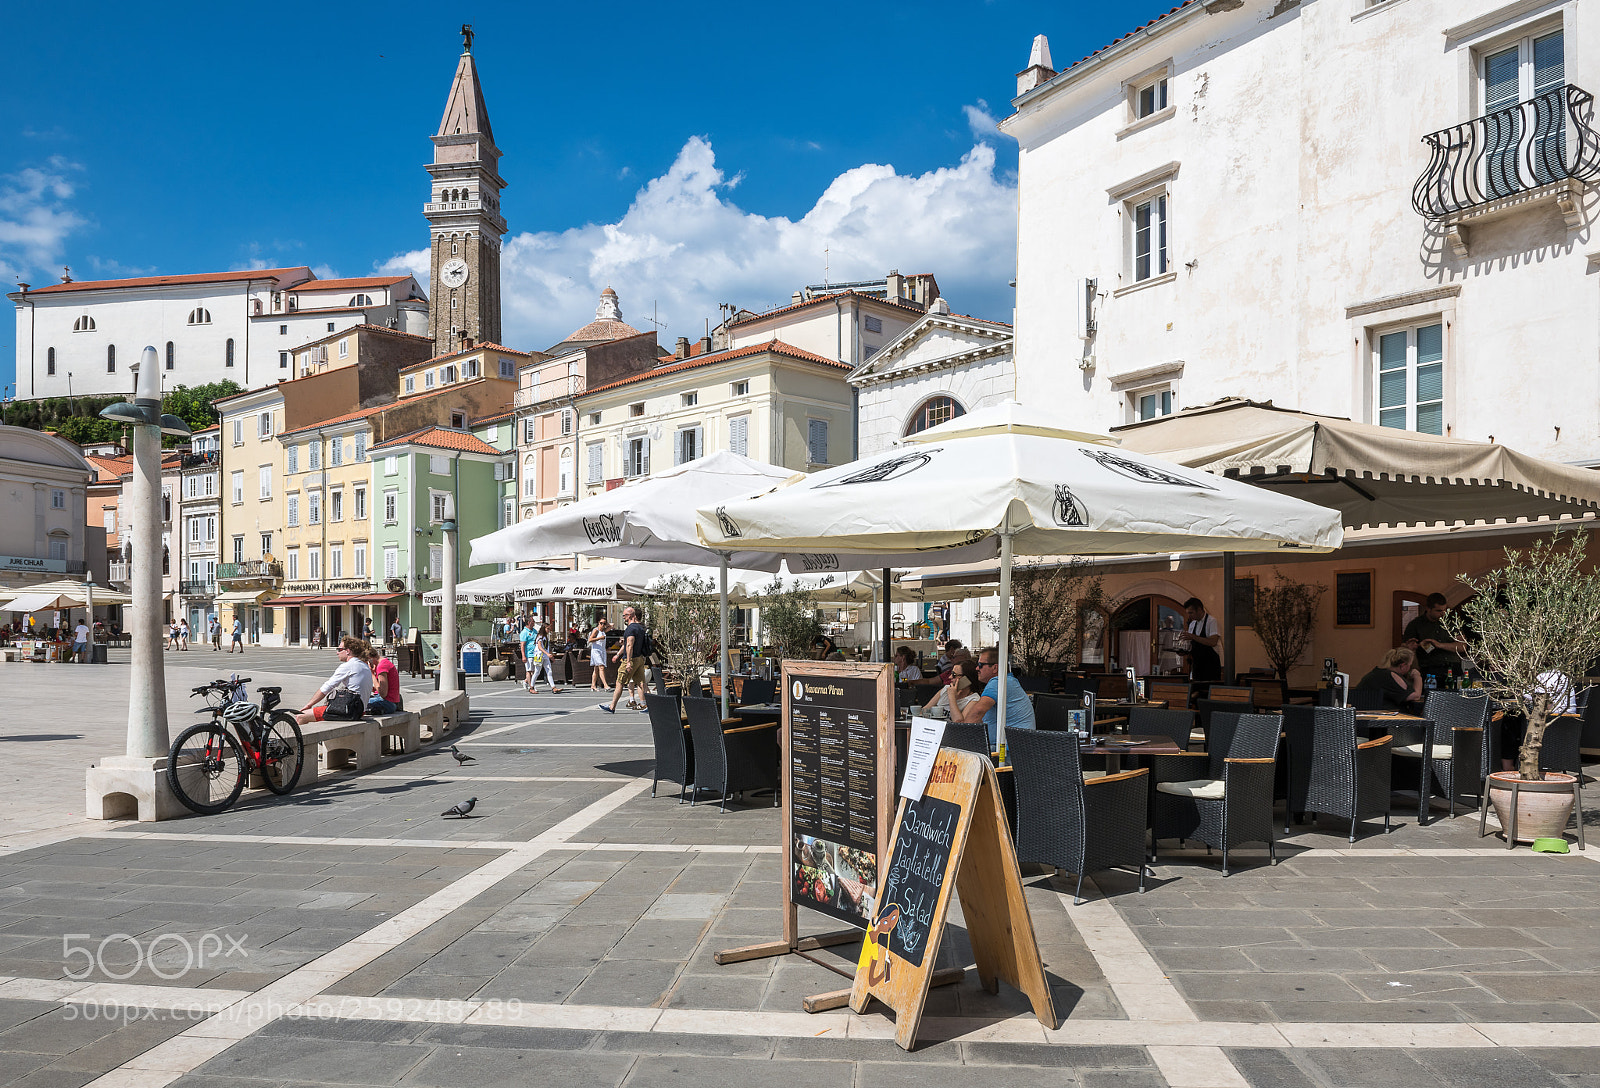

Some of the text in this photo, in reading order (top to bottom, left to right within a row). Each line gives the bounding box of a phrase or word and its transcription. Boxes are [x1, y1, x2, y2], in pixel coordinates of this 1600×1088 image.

[515, 586, 613, 598] TRATTORIA INN GASTHAUS
[828, 684, 844, 696] Piran
[929, 760, 958, 784] ockta
[902, 800, 951, 849] Sandwich
[895, 837, 943, 888] Tagliatelle
[897, 887, 936, 928] Salad
